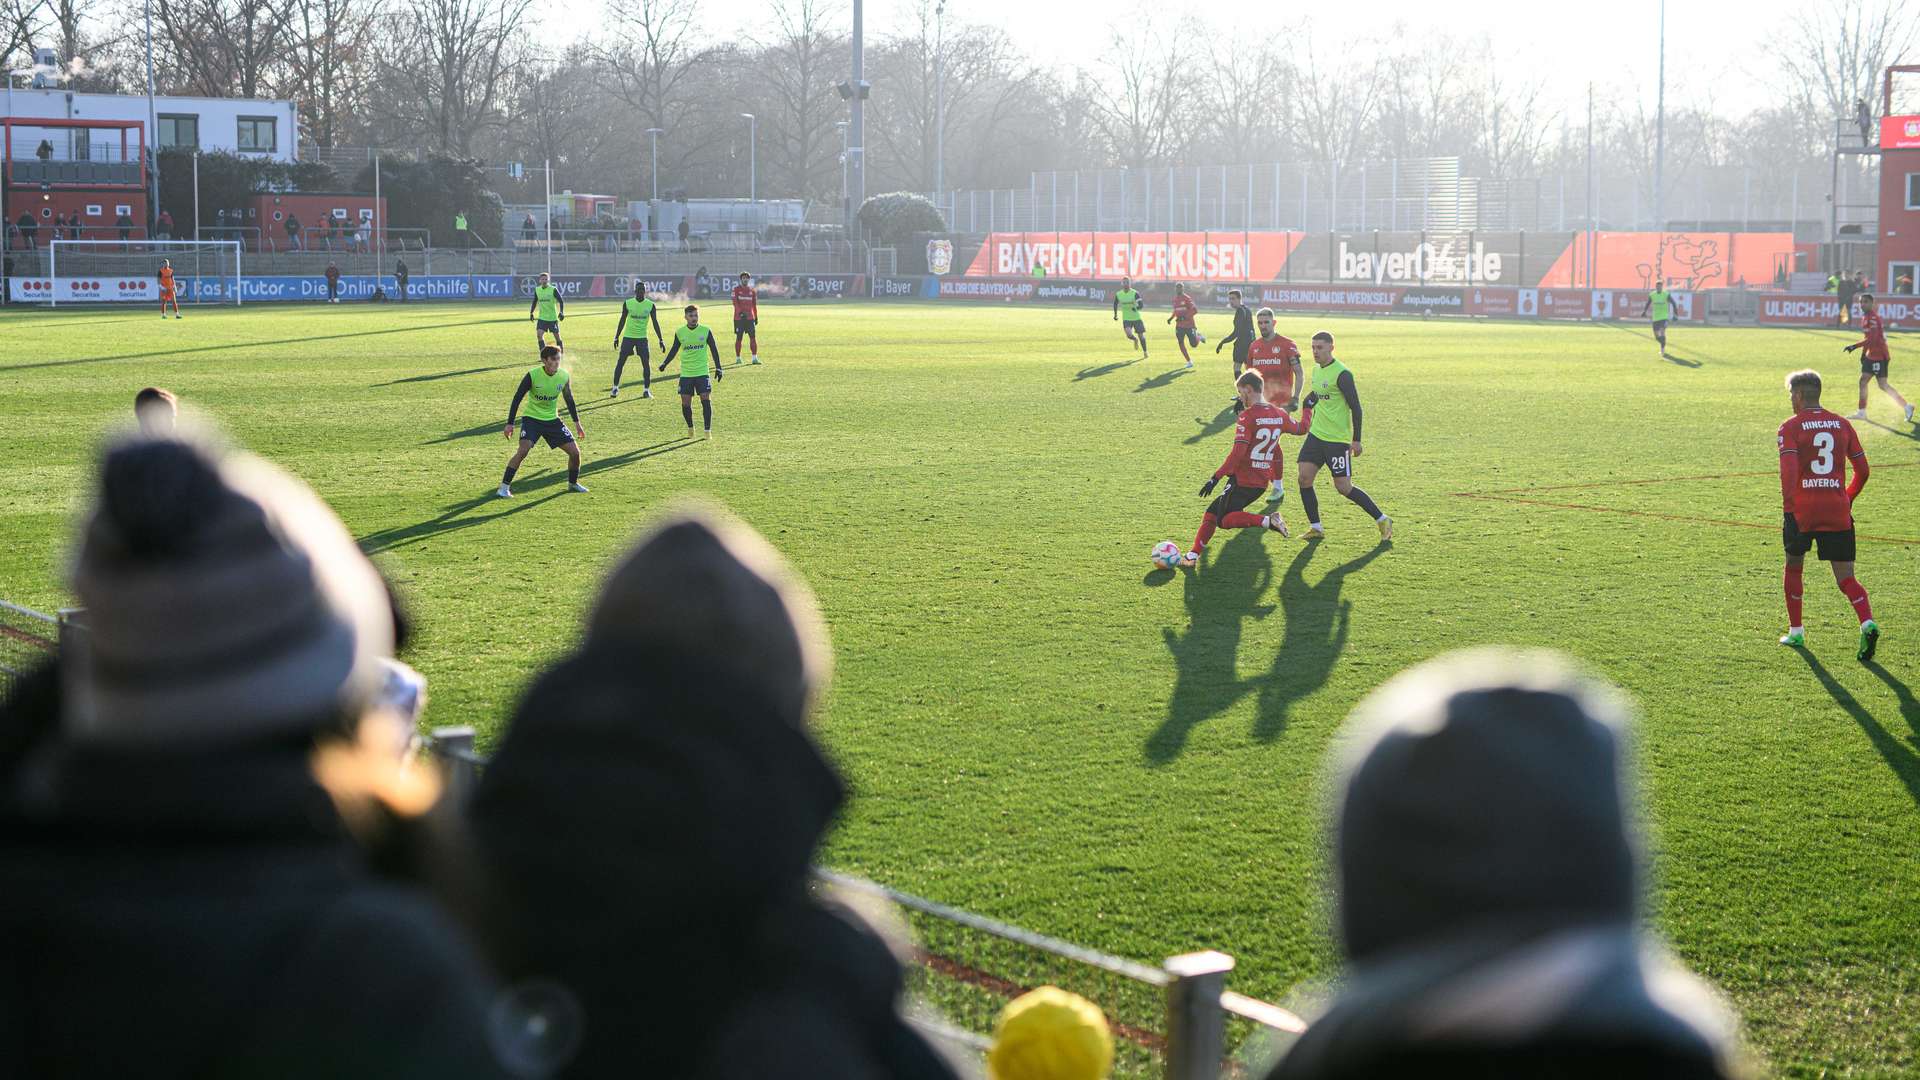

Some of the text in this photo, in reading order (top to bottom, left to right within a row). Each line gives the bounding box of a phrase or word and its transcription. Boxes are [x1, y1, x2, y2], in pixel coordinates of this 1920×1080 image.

[998, 242, 1065, 275] BAYER
[1100, 242, 1251, 278] LEVERKUSEN
[1339, 241, 1502, 285] bayer04.de
[301, 280, 328, 295] Die
[808, 278, 845, 294] Bayer
[886, 279, 912, 294] Bayer
[1801, 420, 1841, 430] HINCAPIE
[1250, 428, 1282, 461] 22
[1810, 431, 1835, 475] 3
[1331, 456, 1345, 470] 29
